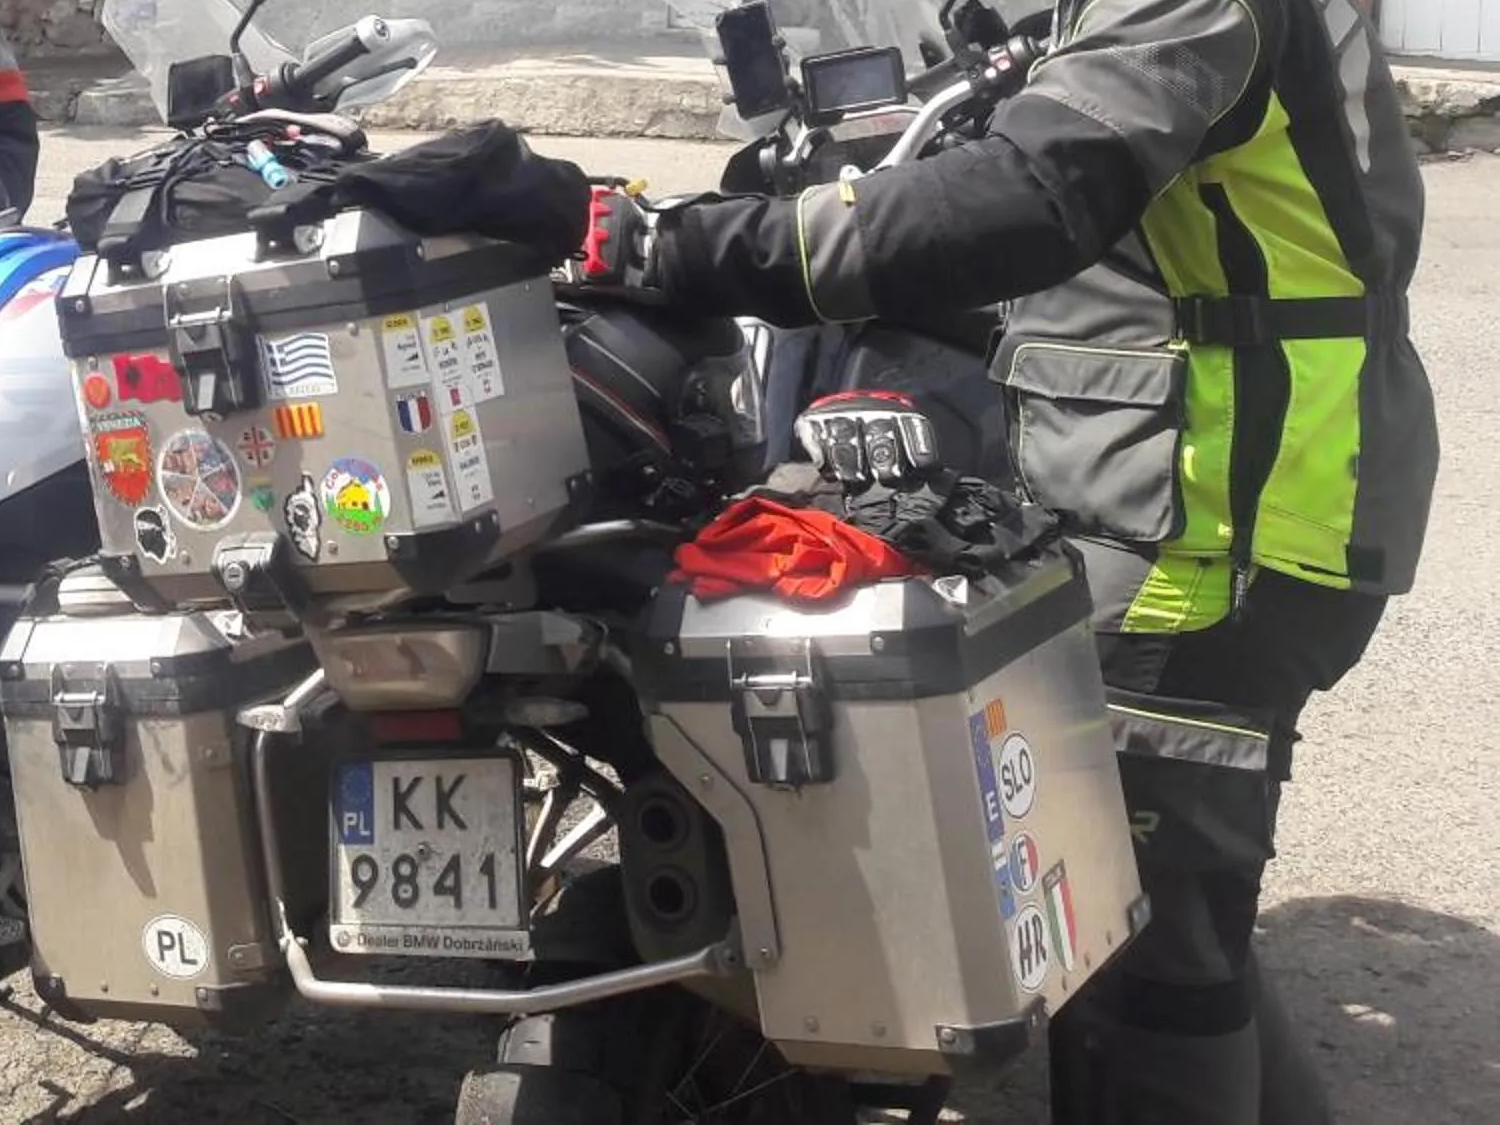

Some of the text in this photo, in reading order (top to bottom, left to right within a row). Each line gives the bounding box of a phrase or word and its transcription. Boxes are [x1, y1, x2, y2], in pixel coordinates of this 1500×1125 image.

[393, 774, 468, 830] KK
[1001, 748, 1032, 802] SLO
[343, 811, 371, 837] PL
[351, 853, 497, 910] 9841
[157, 930, 198, 965] PL
[357, 933, 400, 948] Dealer
[403, 935, 440, 949] BMW
[1018, 914, 1047, 979] HR
